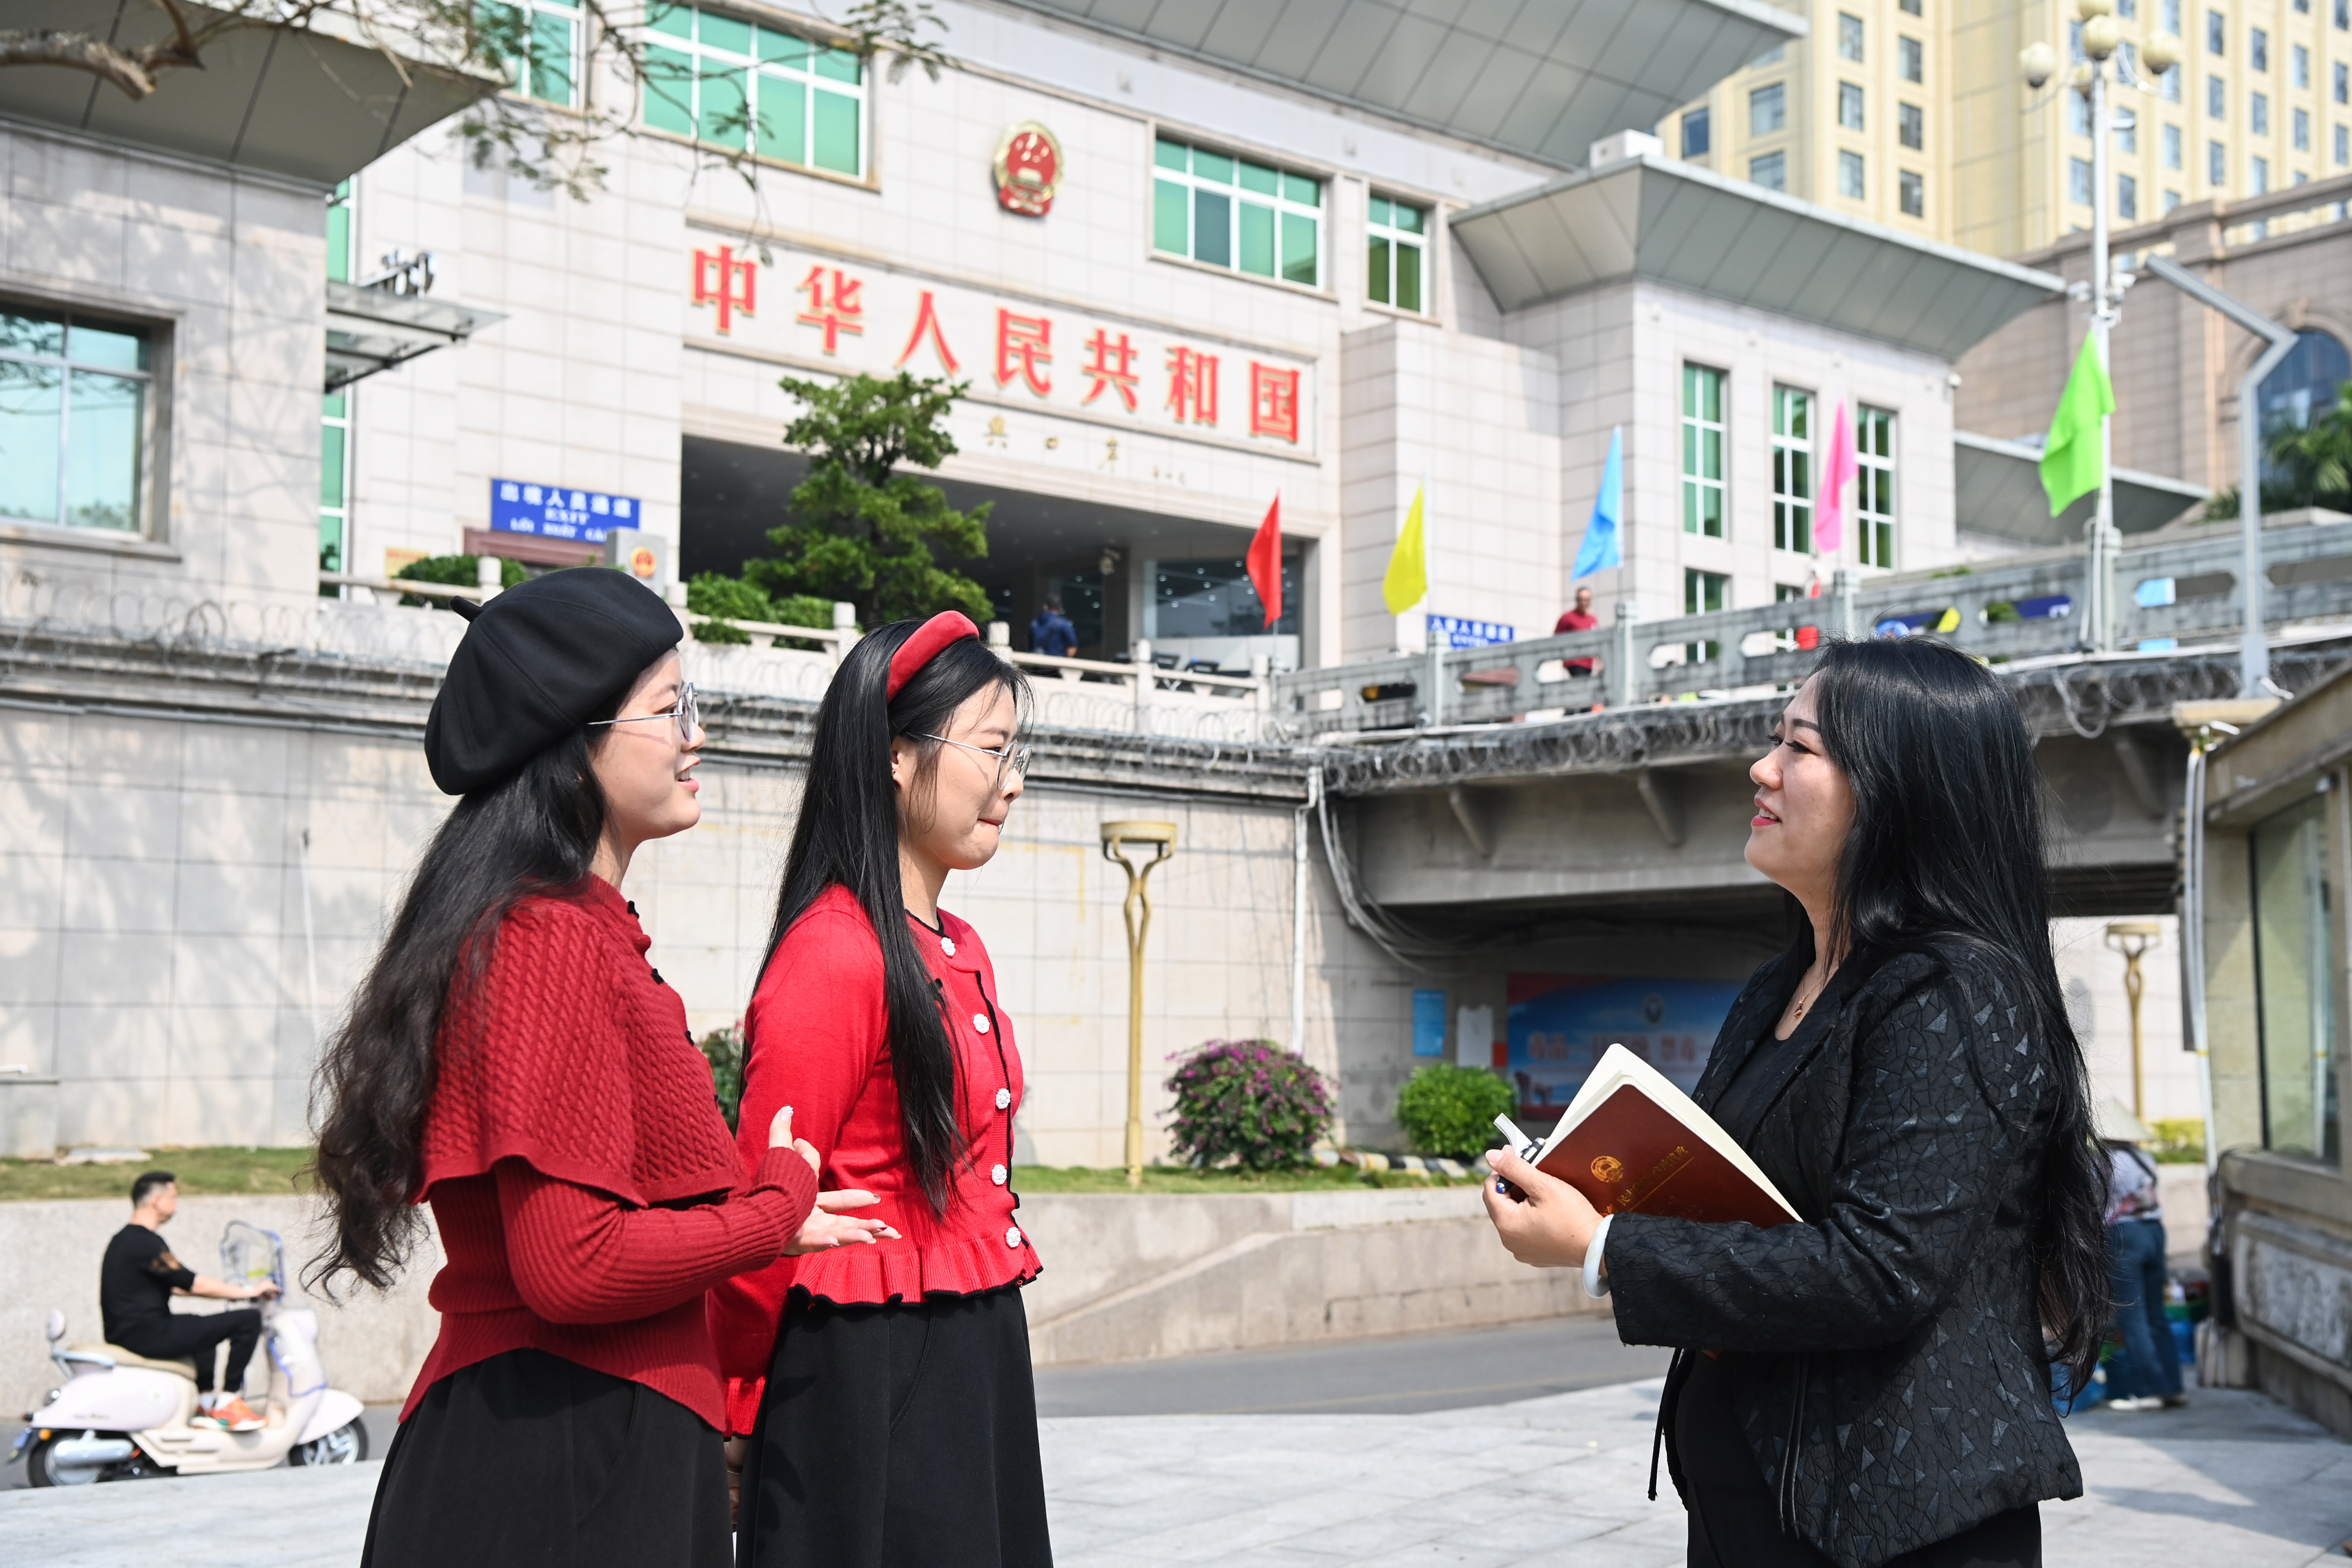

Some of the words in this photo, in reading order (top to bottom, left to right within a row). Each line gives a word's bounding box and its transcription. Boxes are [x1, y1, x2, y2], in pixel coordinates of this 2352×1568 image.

[691, 244, 1301, 444] 中华人民共和国
